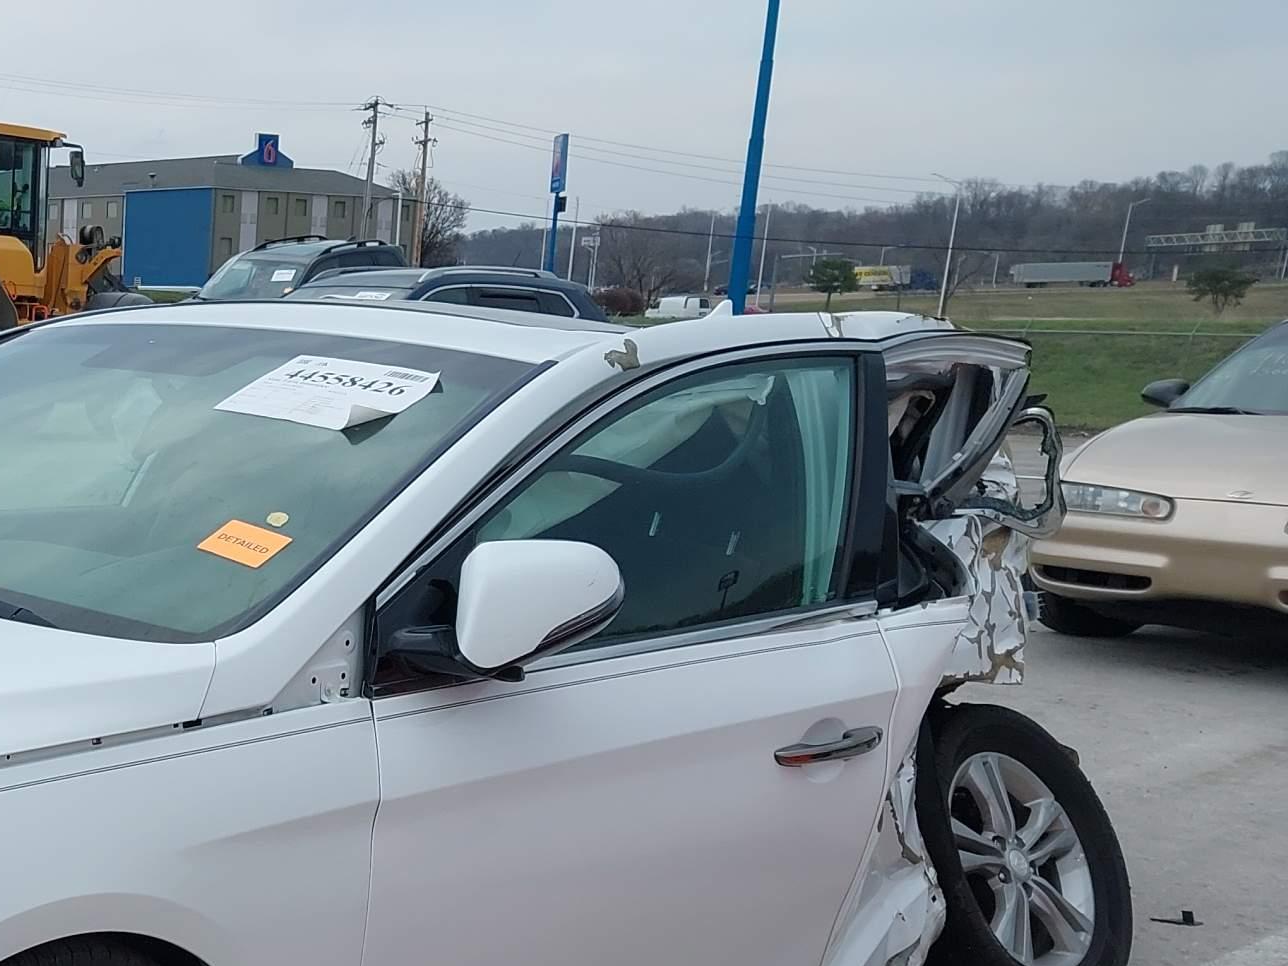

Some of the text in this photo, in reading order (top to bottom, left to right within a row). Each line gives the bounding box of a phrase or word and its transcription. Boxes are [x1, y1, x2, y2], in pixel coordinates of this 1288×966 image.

[264, 139, 276, 163] 6
[285, 368, 414, 396] 44558426
[217, 532, 270, 554] DETAILED
